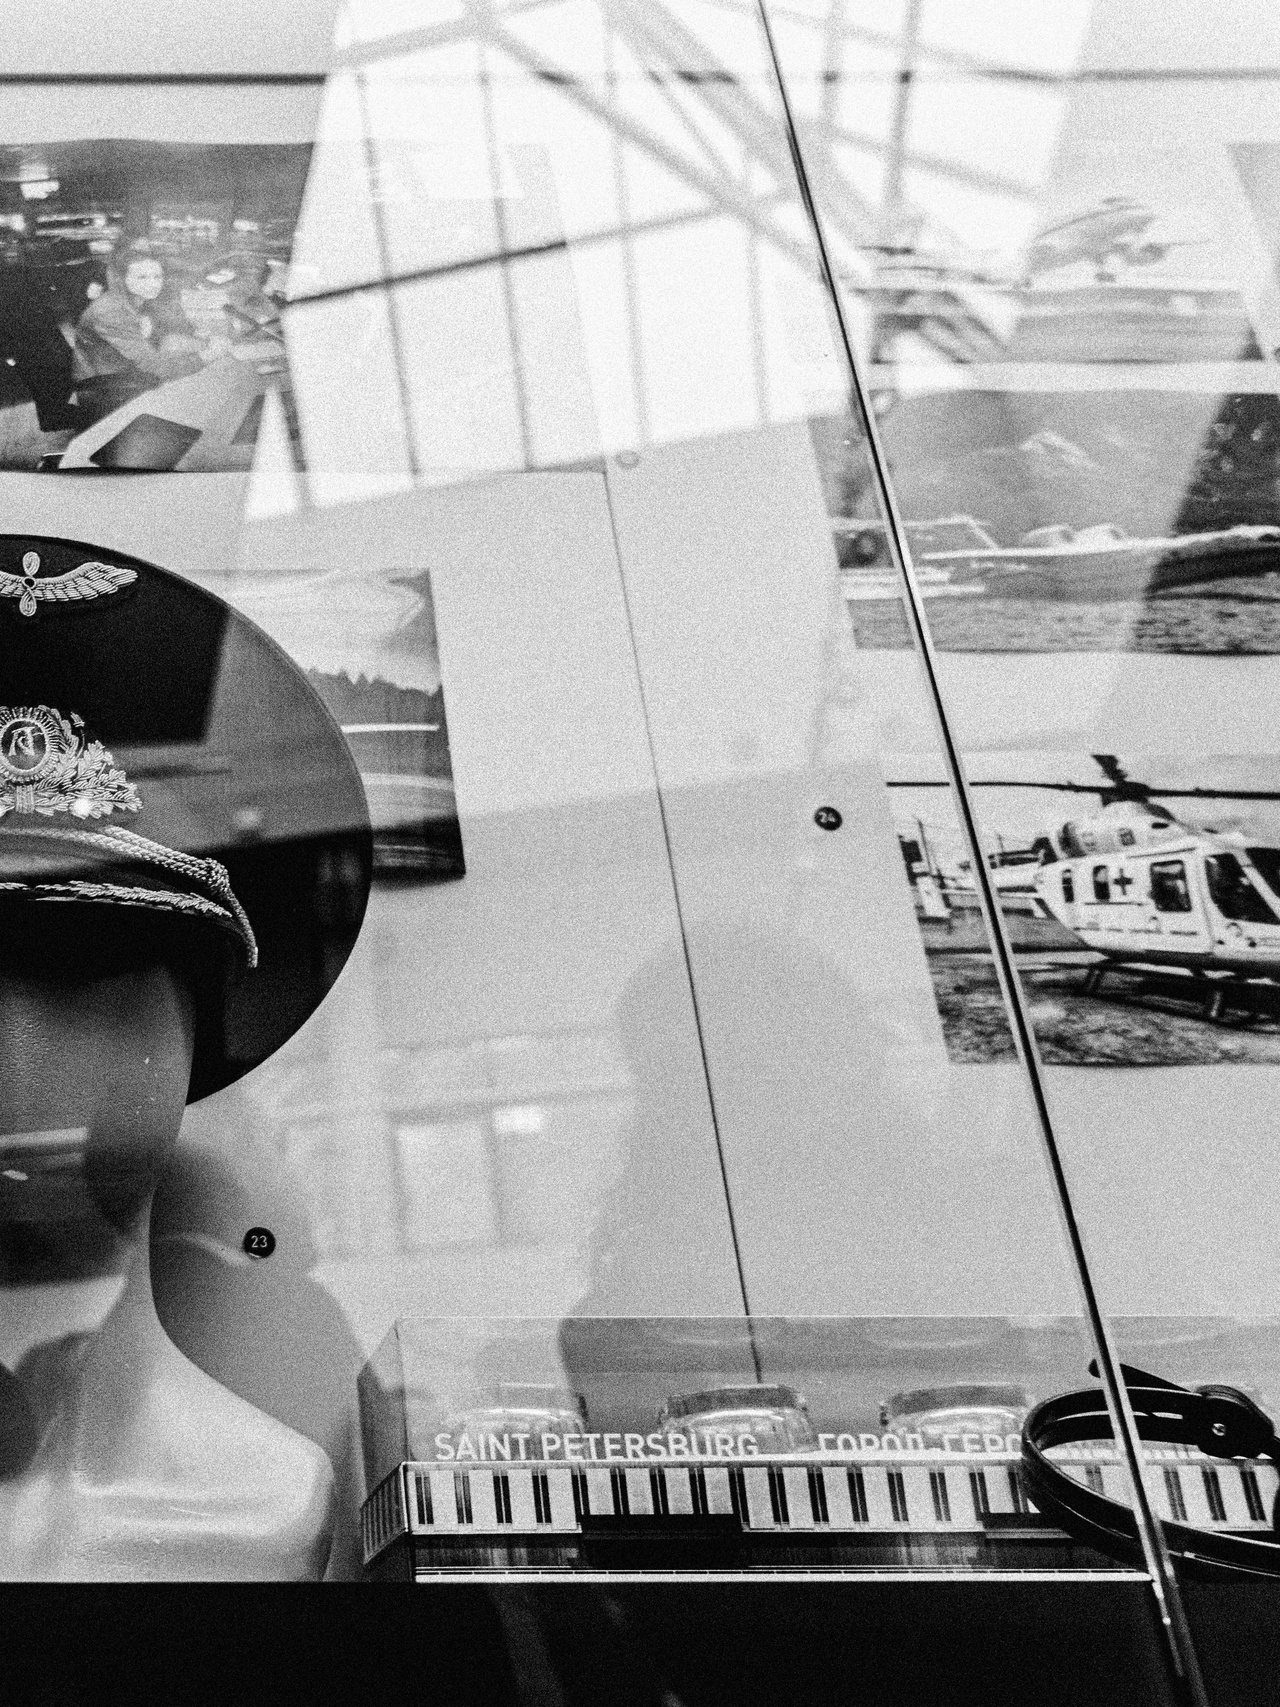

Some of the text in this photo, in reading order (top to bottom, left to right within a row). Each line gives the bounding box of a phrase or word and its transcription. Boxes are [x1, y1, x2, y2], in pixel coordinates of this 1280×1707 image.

[250, 1233, 269, 1248] 23
[434, 1433, 759, 1461] SAINT PETERSBURG
